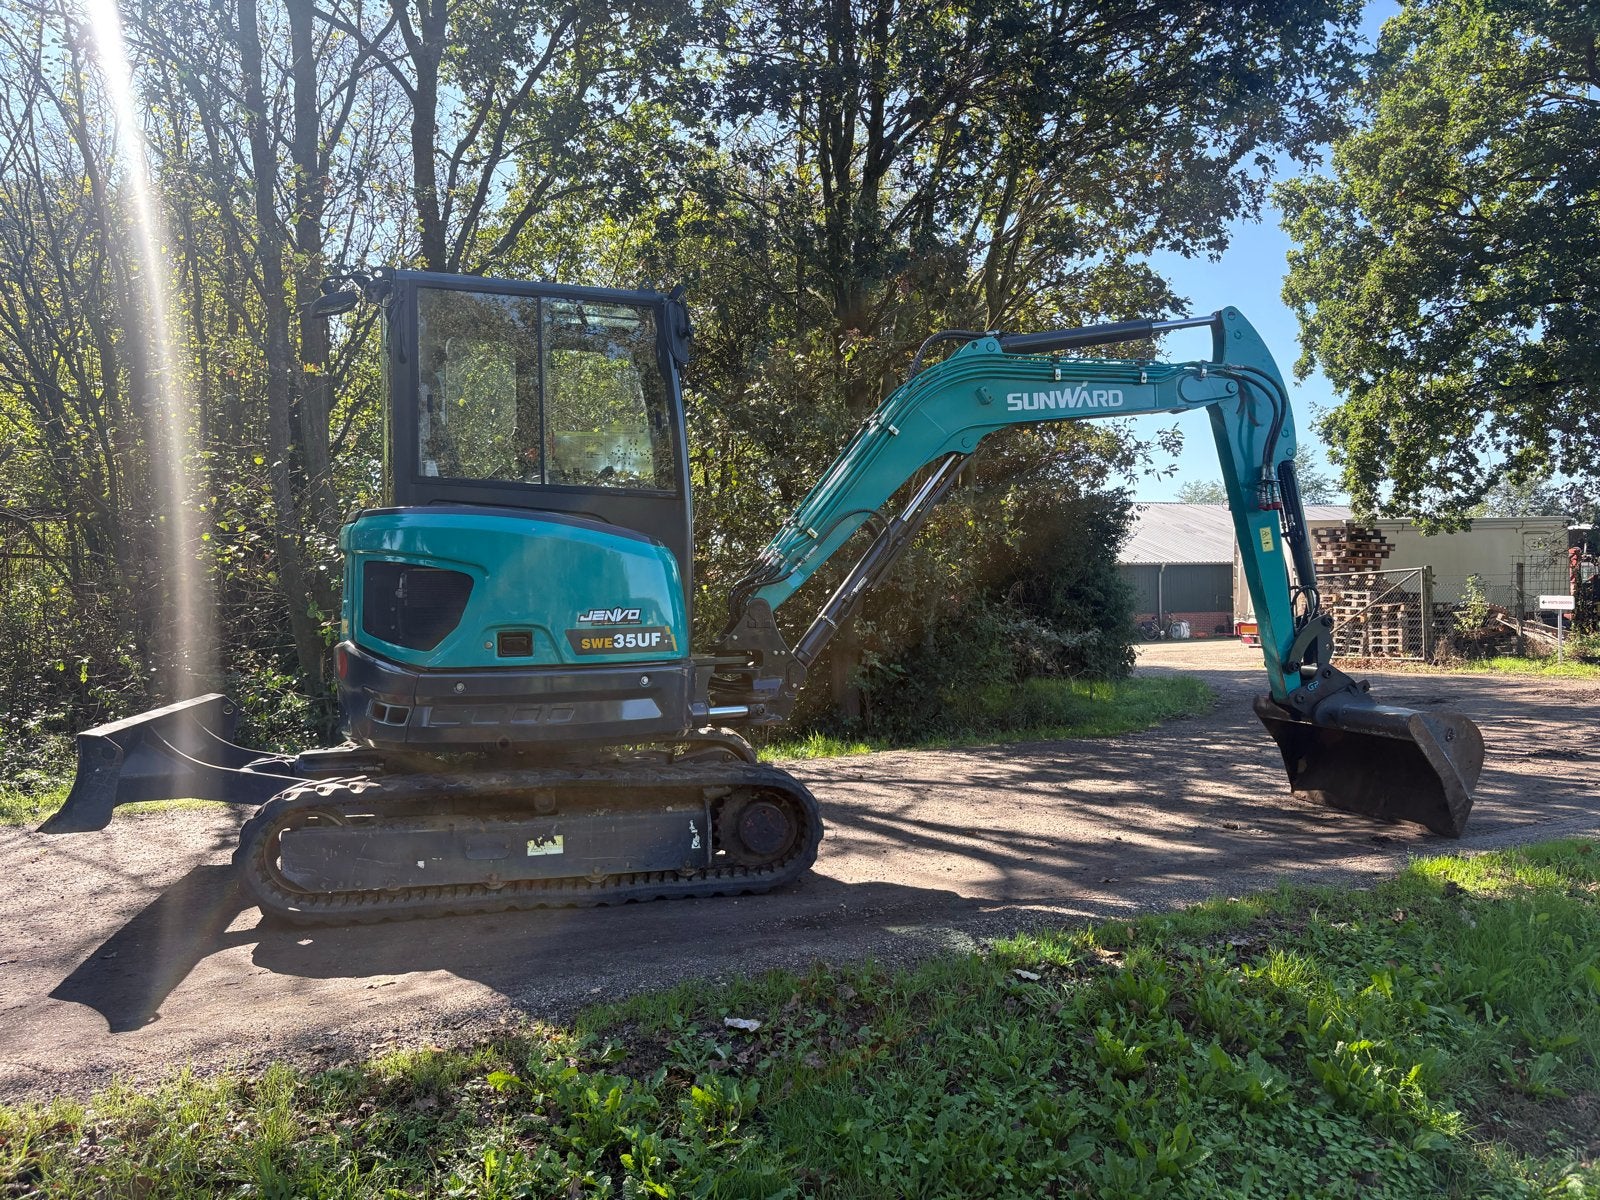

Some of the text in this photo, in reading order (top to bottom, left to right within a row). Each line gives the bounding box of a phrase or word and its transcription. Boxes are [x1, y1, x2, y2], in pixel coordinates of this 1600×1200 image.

[1007, 381, 1124, 411] SUNWARD
[580, 608, 641, 622] JENVO
[581, 633, 661, 650] SWE35UF
